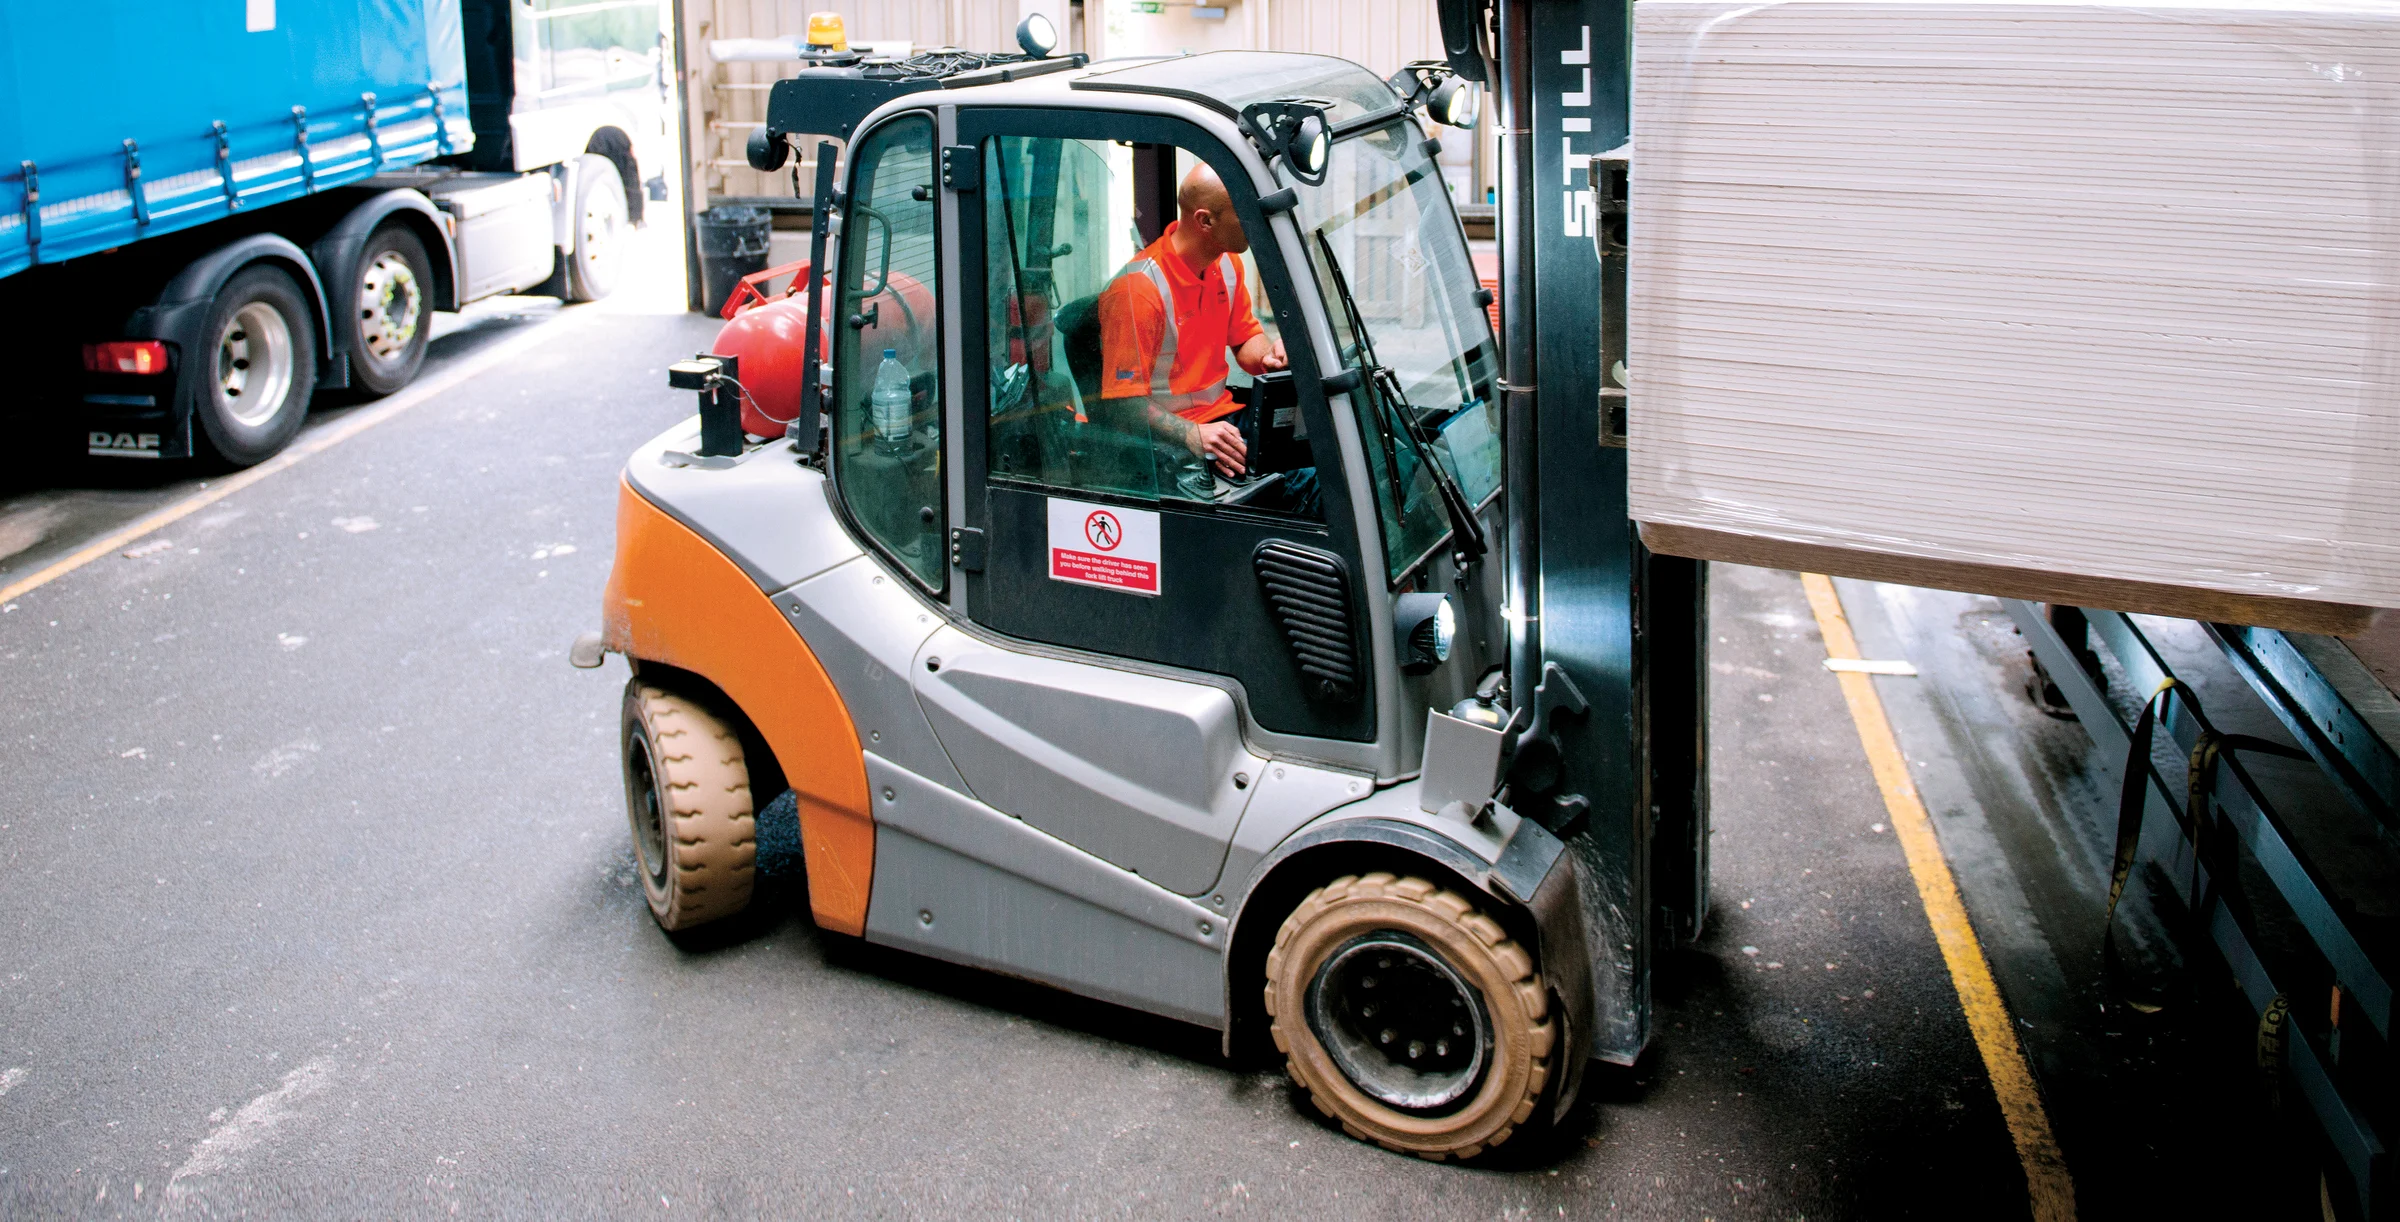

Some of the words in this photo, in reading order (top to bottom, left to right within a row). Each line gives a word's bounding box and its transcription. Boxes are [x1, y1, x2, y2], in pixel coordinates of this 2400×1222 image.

[1561, 25, 1594, 238] STILL
[89, 431, 160, 449] DAF
[1061, 552, 1076, 560] Make
[1102, 559, 1120, 567] driver
[1121, 561, 1132, 569] has
[1072, 561, 1091, 570] before
[1092, 565, 1115, 575] walking
[1115, 568, 1136, 577] behind
[1137, 571, 1149, 579] this
[1098, 573, 1106, 581] lift
[1107, 575, 1123, 583] truck
